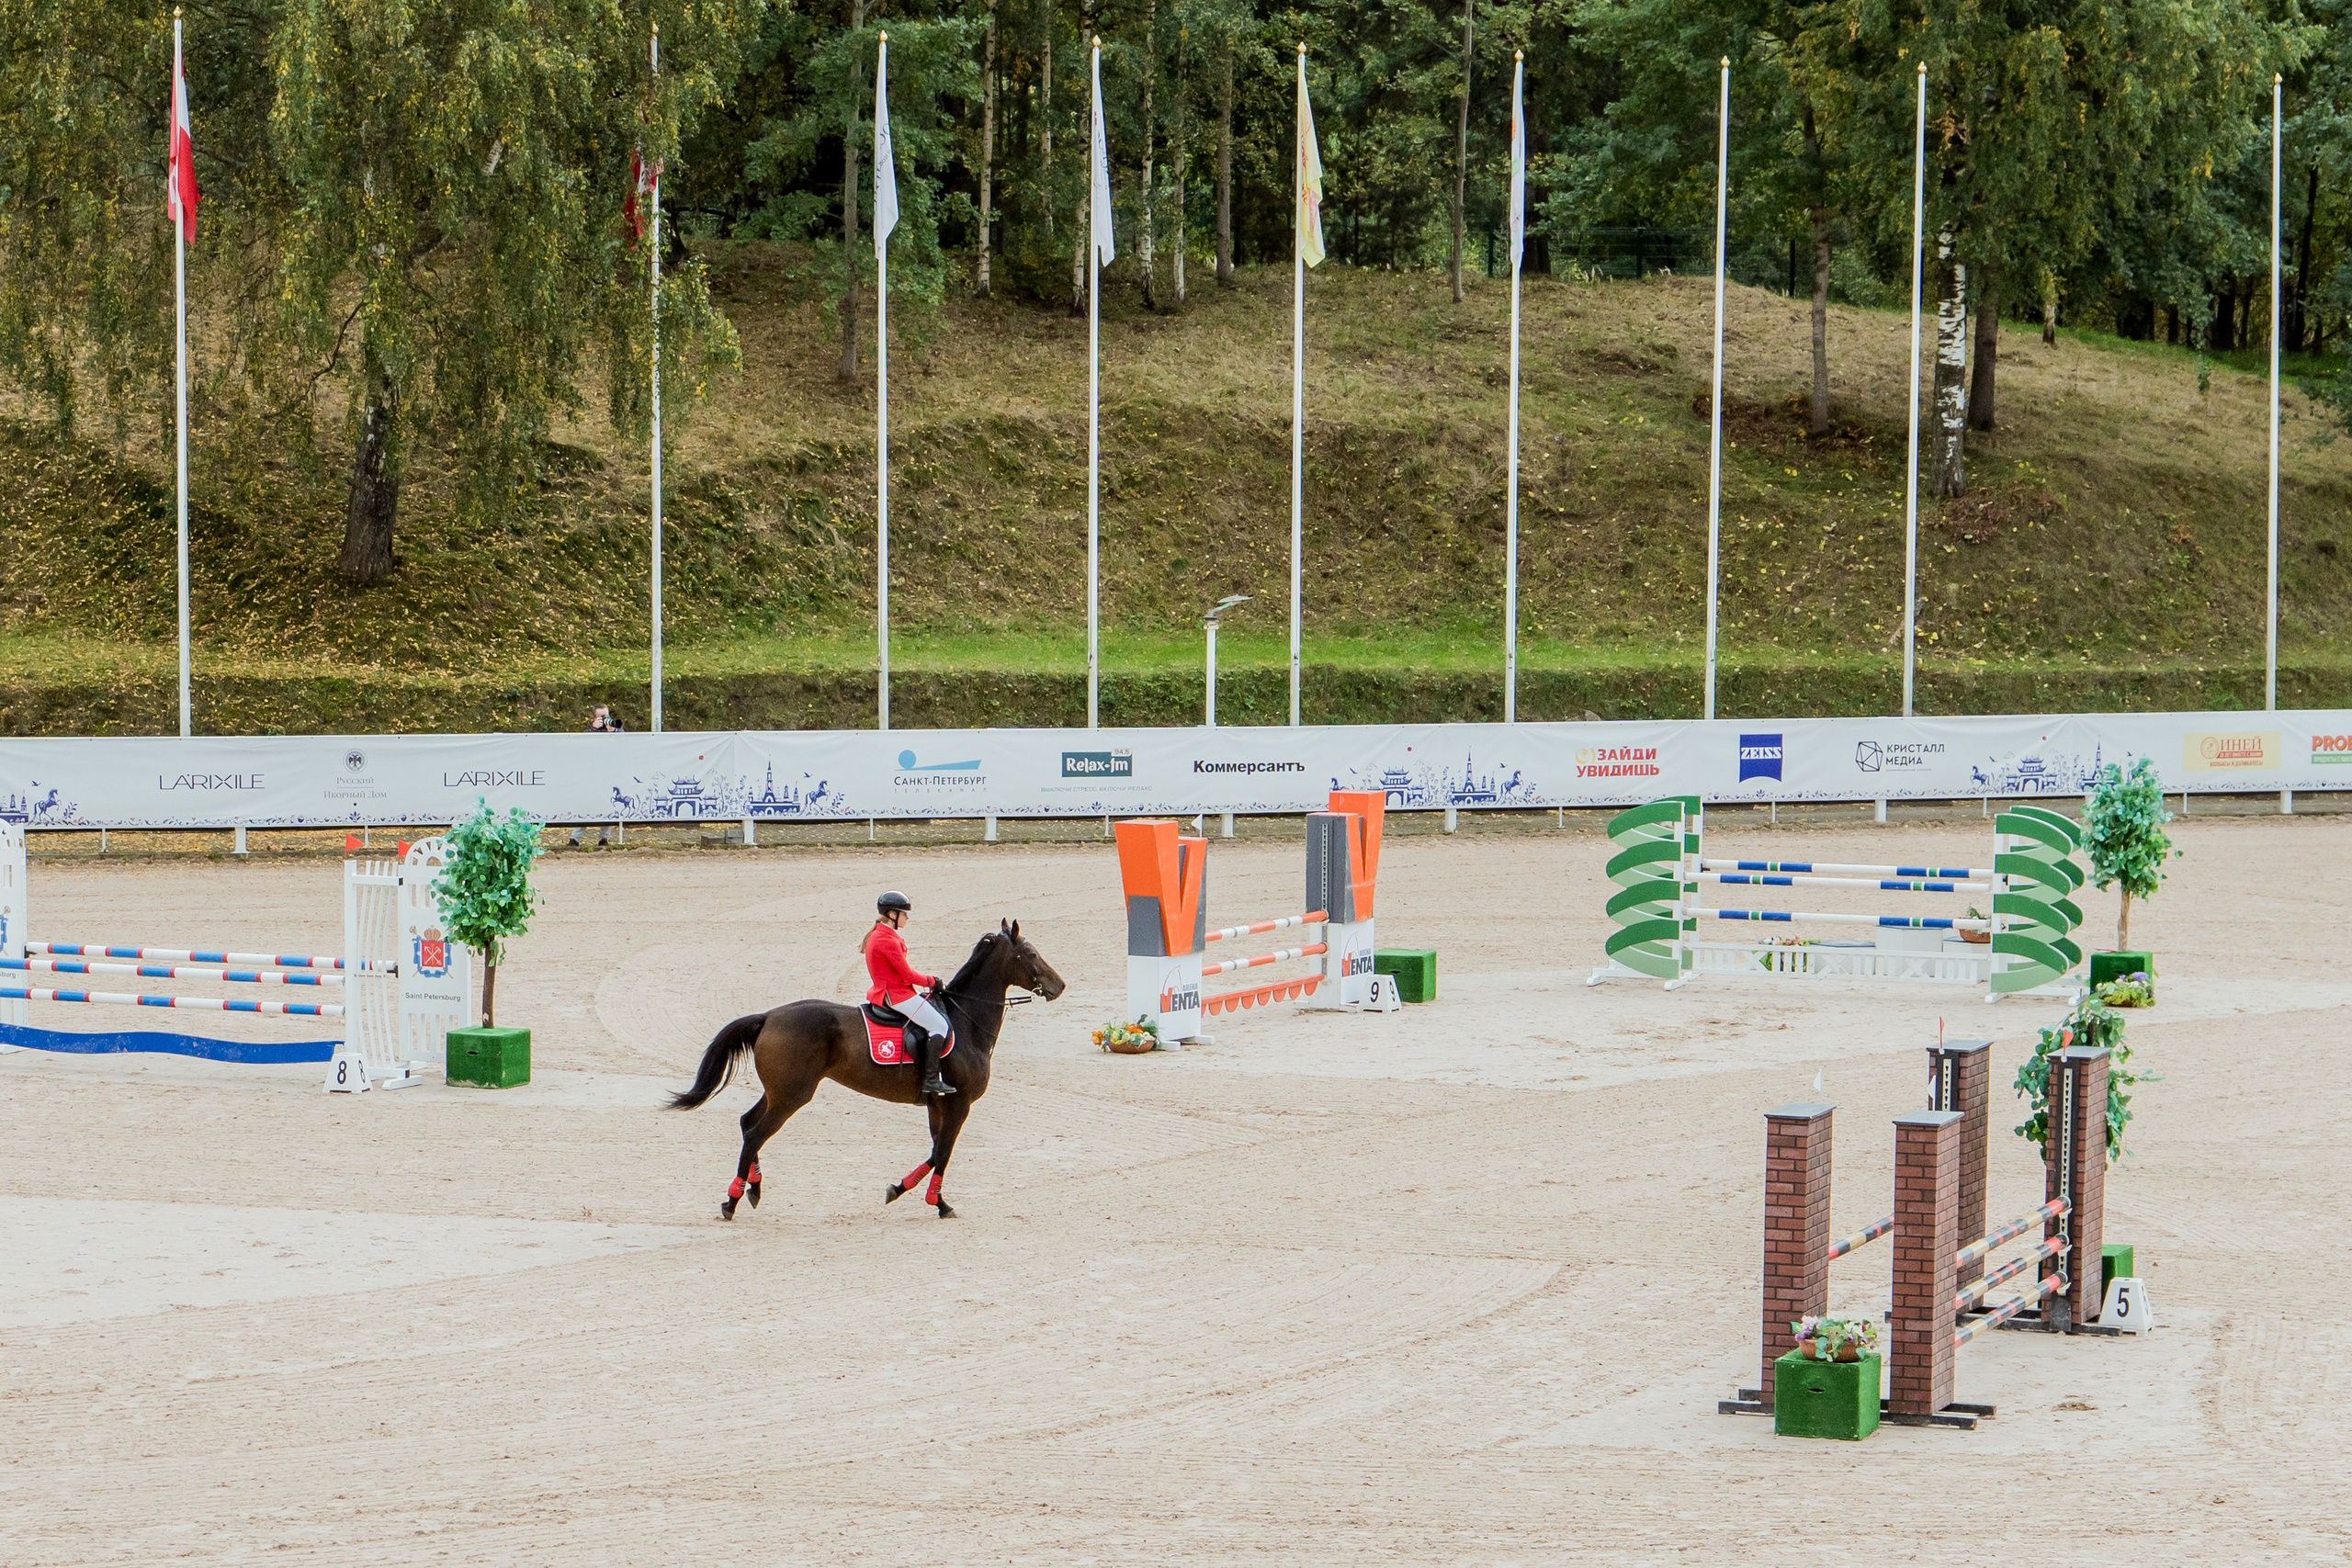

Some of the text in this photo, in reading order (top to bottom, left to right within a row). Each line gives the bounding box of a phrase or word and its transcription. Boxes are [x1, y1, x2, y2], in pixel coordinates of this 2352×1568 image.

[1886, 743, 1945, 753] КРИСТАЛЛ
[2221, 736, 2262, 750] ИНЕЙ
[1597, 746, 1657, 761] ЗАЙДИ
[1741, 746, 1782, 760] ZEISS
[1193, 761, 1306, 775] Коммерсантъ
[1885, 756, 1923, 766] МЕДИА
[1577, 763, 1660, 778] УВИДИШЬ
[1341, 952, 1374, 977] VENTA
[424, 993, 461, 1002] Petersburg
[1370, 981, 1380, 1002] 9
[1159, 987, 1201, 1013] VENTA
[336, 1060, 347, 1085] 8
[2117, 1287, 2130, 1318] 5
